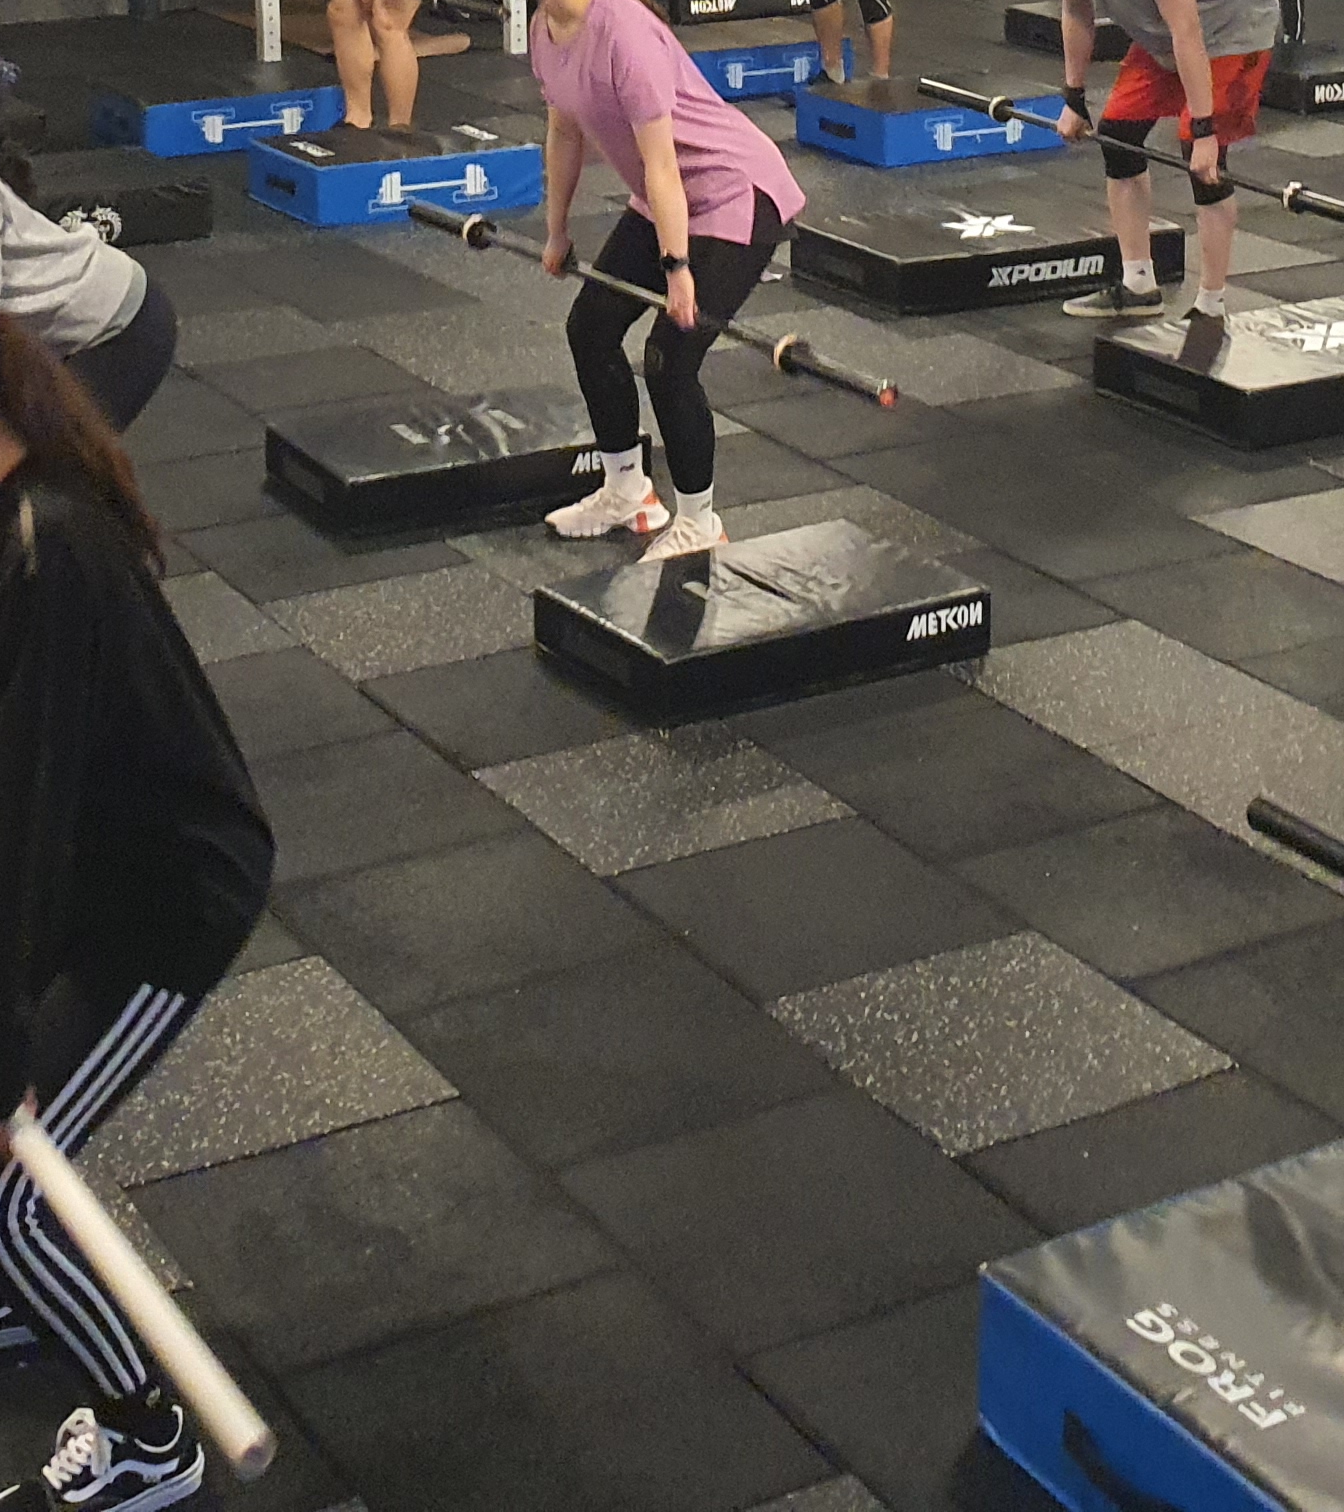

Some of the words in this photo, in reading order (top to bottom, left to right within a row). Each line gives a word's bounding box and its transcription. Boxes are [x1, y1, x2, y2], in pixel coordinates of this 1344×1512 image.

[988, 254, 1104, 288] XPODIUM
[906, 600, 983, 641] METCON
[1126, 1309, 1288, 1429] FROG
